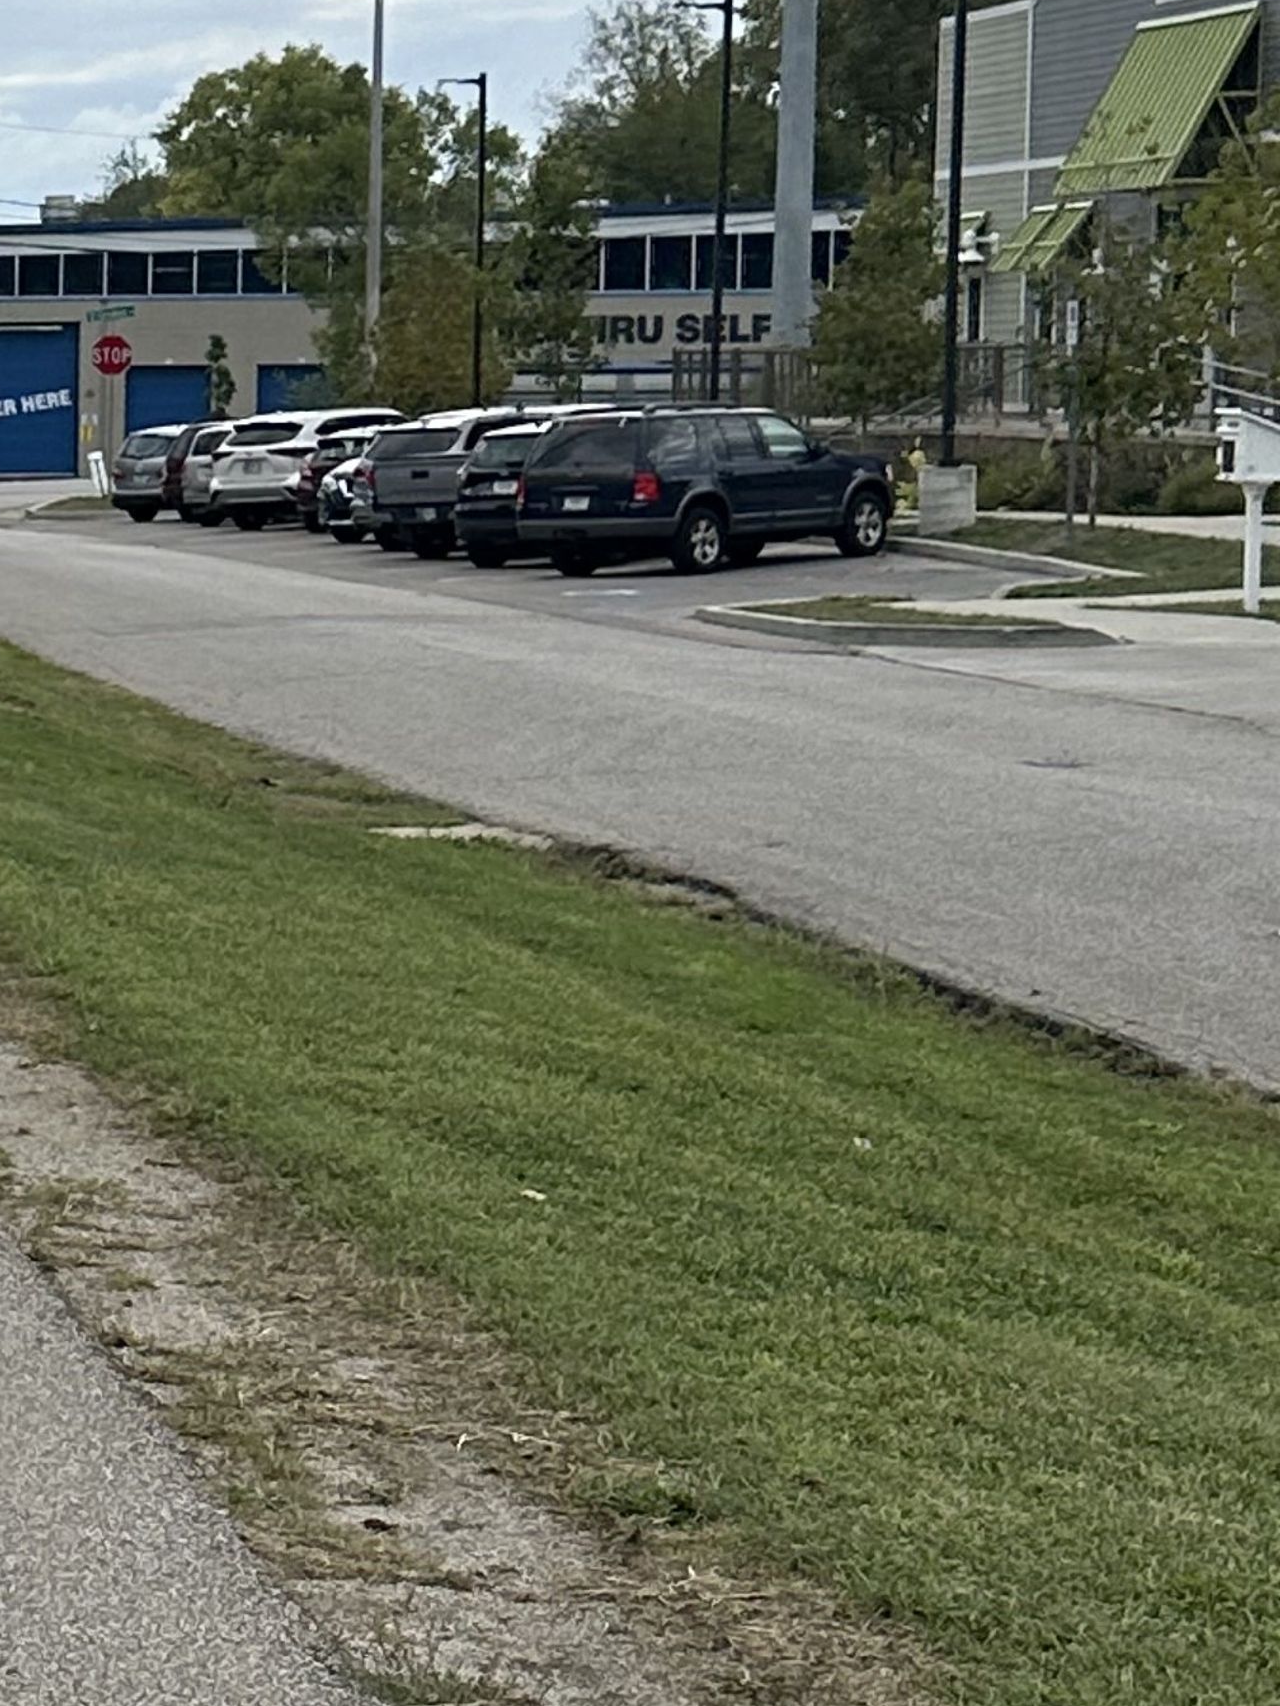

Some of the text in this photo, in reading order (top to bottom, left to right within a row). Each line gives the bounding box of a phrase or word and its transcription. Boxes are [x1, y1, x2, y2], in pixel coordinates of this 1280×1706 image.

[675, 314, 772, 344] SELF
[92, 346, 133, 365] STOP
[20, 389, 73, 413] HERE
